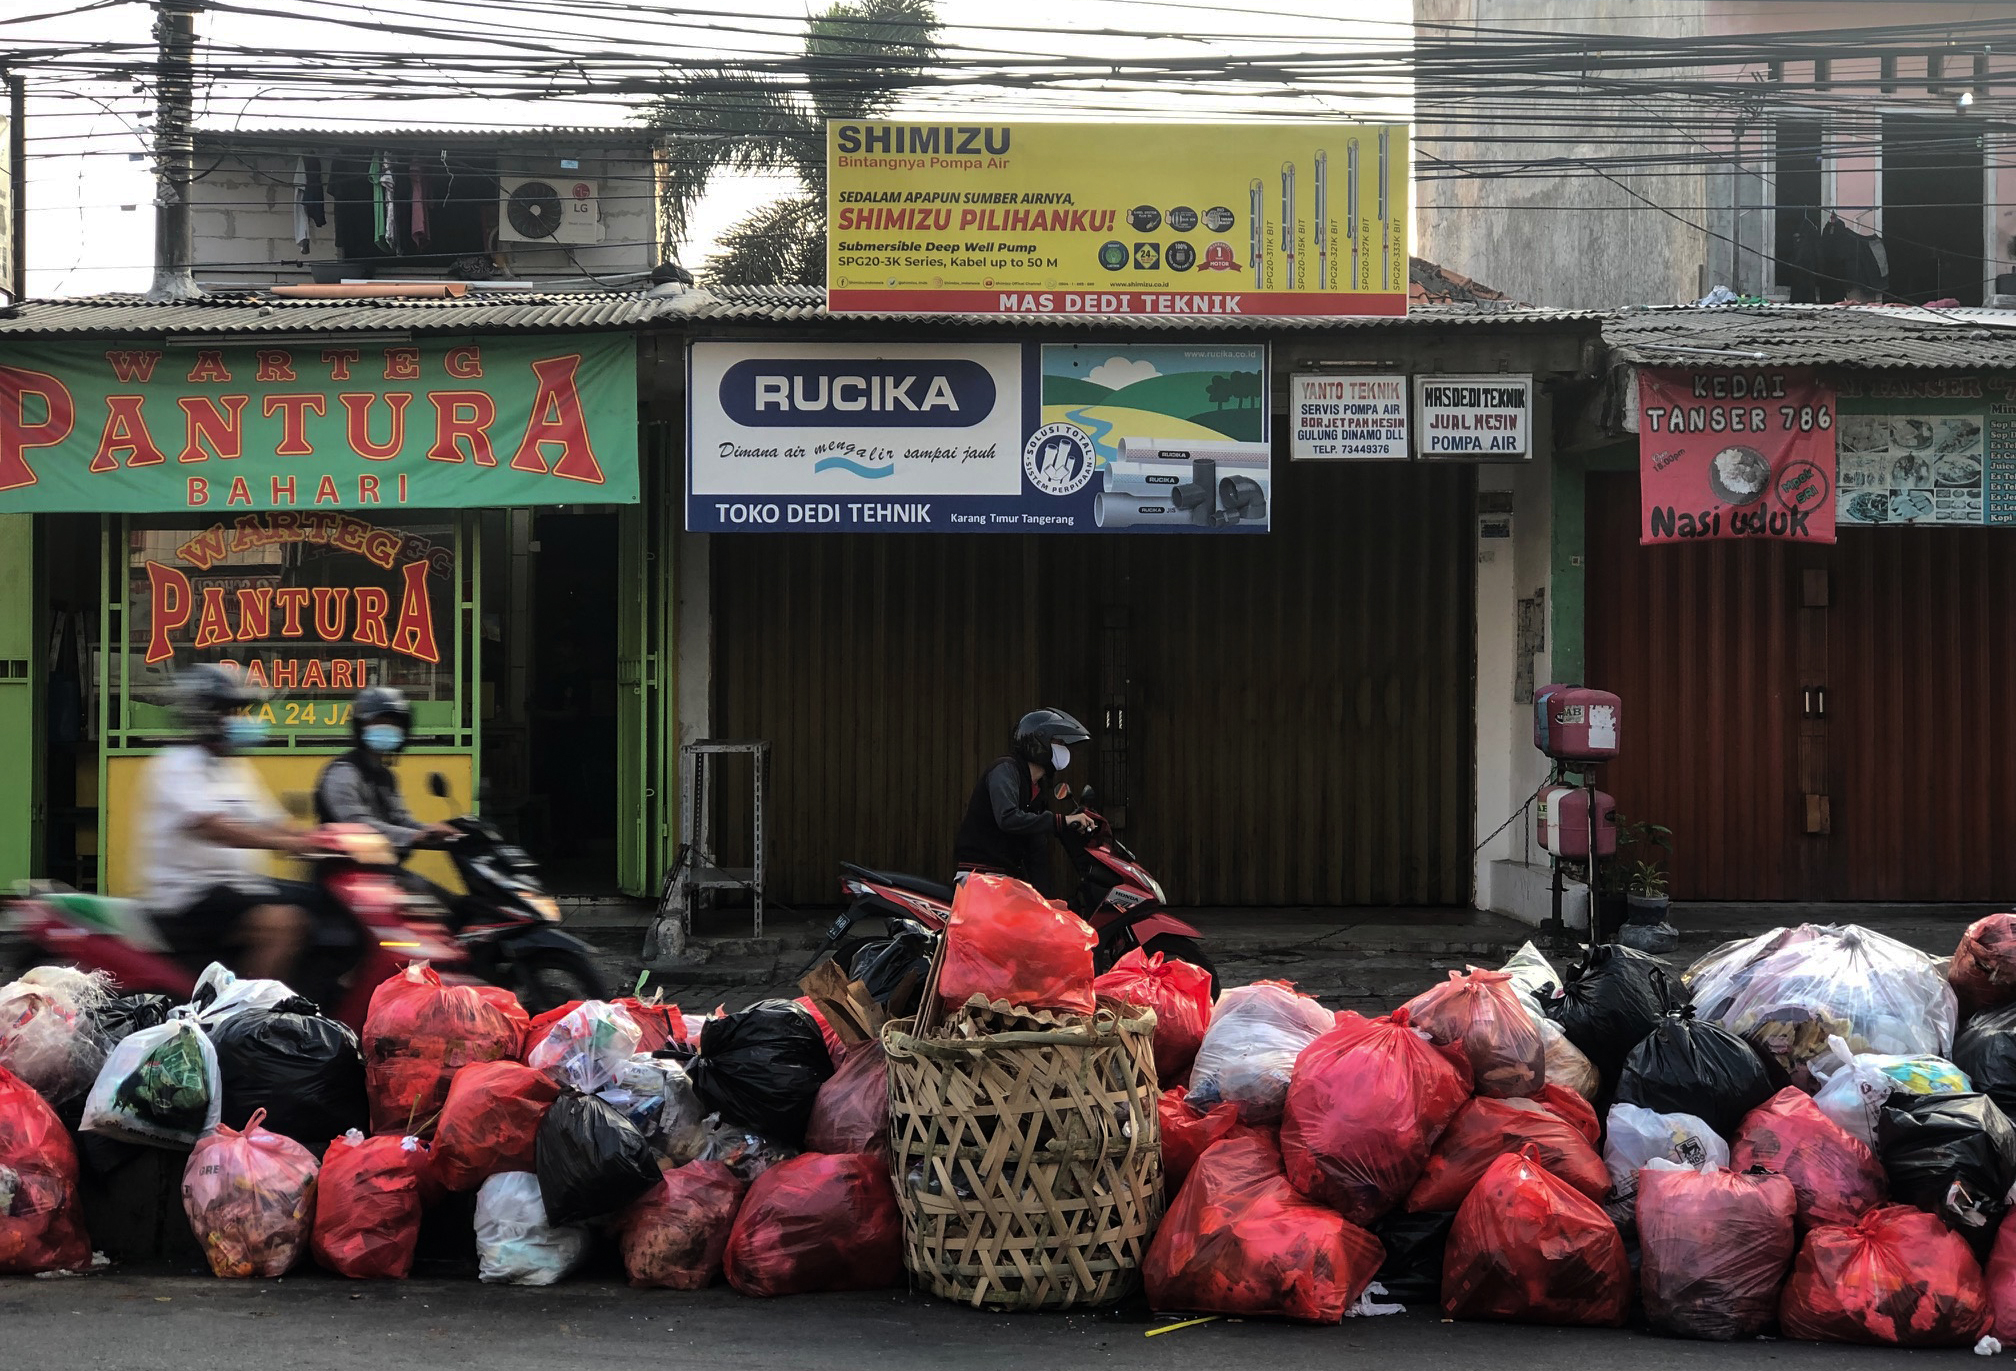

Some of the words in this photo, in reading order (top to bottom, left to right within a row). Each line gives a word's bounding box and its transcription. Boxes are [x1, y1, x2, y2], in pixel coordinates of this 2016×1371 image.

[837, 126, 1010, 154] SHIMIZU
[838, 156, 925, 170] Bintangnya
[930, 157, 982, 171] Pompa
[987, 157, 1010, 169] Air
[838, 191, 902, 203] SEDALAM
[904, 192, 961, 204] APAPUN
[963, 193, 1018, 204] SUMBER
[1020, 193, 1075, 206] AIRNYA,
[574, 203, 588, 213] LG
[838, 207, 952, 231] SHIMIZU
[959, 209, 1116, 232] PILIHANKU!
[1266, 220, 1274, 235] BIT
[1330, 219, 1338, 234] BIT
[1393, 218, 1401, 233] BIT
[838, 240, 922, 252] Submersible
[925, 241, 960, 254] Deep
[964, 242, 994, 252] Well
[998, 243, 1036, 254] Pump
[1140, 250, 1151, 258] 24
[838, 256, 901, 267] SPG20-3K
[904, 256, 947, 269] Series,
[950, 257, 986, 267] Kabel
[990, 259, 1008, 270] up
[1010, 258, 1024, 268] to
[1027, 257, 1043, 268] 50
[1047, 258, 1058, 268] M
[1000, 293, 1054, 312] MAS
[1065, 294, 1131, 313] DEDI
[1141, 295, 1242, 313] TEKNIK
[1184, 350, 1256, 358] www.rucika.co.id
[106, 346, 484, 382] WARTEG
[755, 375, 960, 411] RUCIKA
[1301, 381, 1344, 400] YANTO
[1349, 382, 1400, 400] TEKNIK
[1693, 373, 1786, 399] KEDAI
[1301, 404, 1340, 415] SERVIS
[1343, 404, 1378, 415] POMPA
[1383, 404, 1400, 415] AIR
[0, 354, 605, 491] PANTURA
[1429, 413, 1471, 430] JUAL
[1646, 405, 1767, 434] TANSER
[1779, 405, 1833, 432] 786
[1991, 421, 2008, 429] Sop
[1027, 426, 1060, 456] SOLUSI
[1065, 426, 1092, 456] TOTAL
[1297, 429, 1338, 441] GULUNG
[1341, 429, 1382, 440] DINAMO
[1385, 429, 1404, 440] DLL
[1431, 435, 1483, 451] POMPA
[1489, 435, 1517, 451] AIR
[1991, 431, 2008, 440] Sop
[718, 441, 779, 459] Dimana
[784, 446, 806, 458] air
[814, 440, 895, 461] mengalir
[903, 446, 958, 463] sampai
[961, 443, 997, 464] jauh
[1312, 445, 1338, 454] TELP.
[1341, 444, 1390, 454] 73449376
[1990, 462, 2015, 470] Juice
[1026, 461, 1049, 490] SISTEM
[1052, 461, 1092, 493] PERPIPAAN
[187, 474, 408, 506] BAHARI
[1990, 493, 2001, 501] Es
[715, 503, 780, 524] TOKO
[787, 504, 840, 523] DEDI
[847, 504, 931, 523] TEHNIK
[950, 513, 986, 525] Karang
[989, 513, 1019, 523] Timur
[1021, 514, 1075, 526] Tangerang
[1651, 505, 1721, 538] Nasi
[1730, 502, 1810, 537] uduk
[1990, 514, 2013, 522] Kopi
[176, 511, 401, 570] WARTEG
[144, 560, 440, 664] PANTURA
[284, 703, 316, 725] 24
[323, 704, 354, 725] JA
[1115, 891, 1139, 902] HONDA
